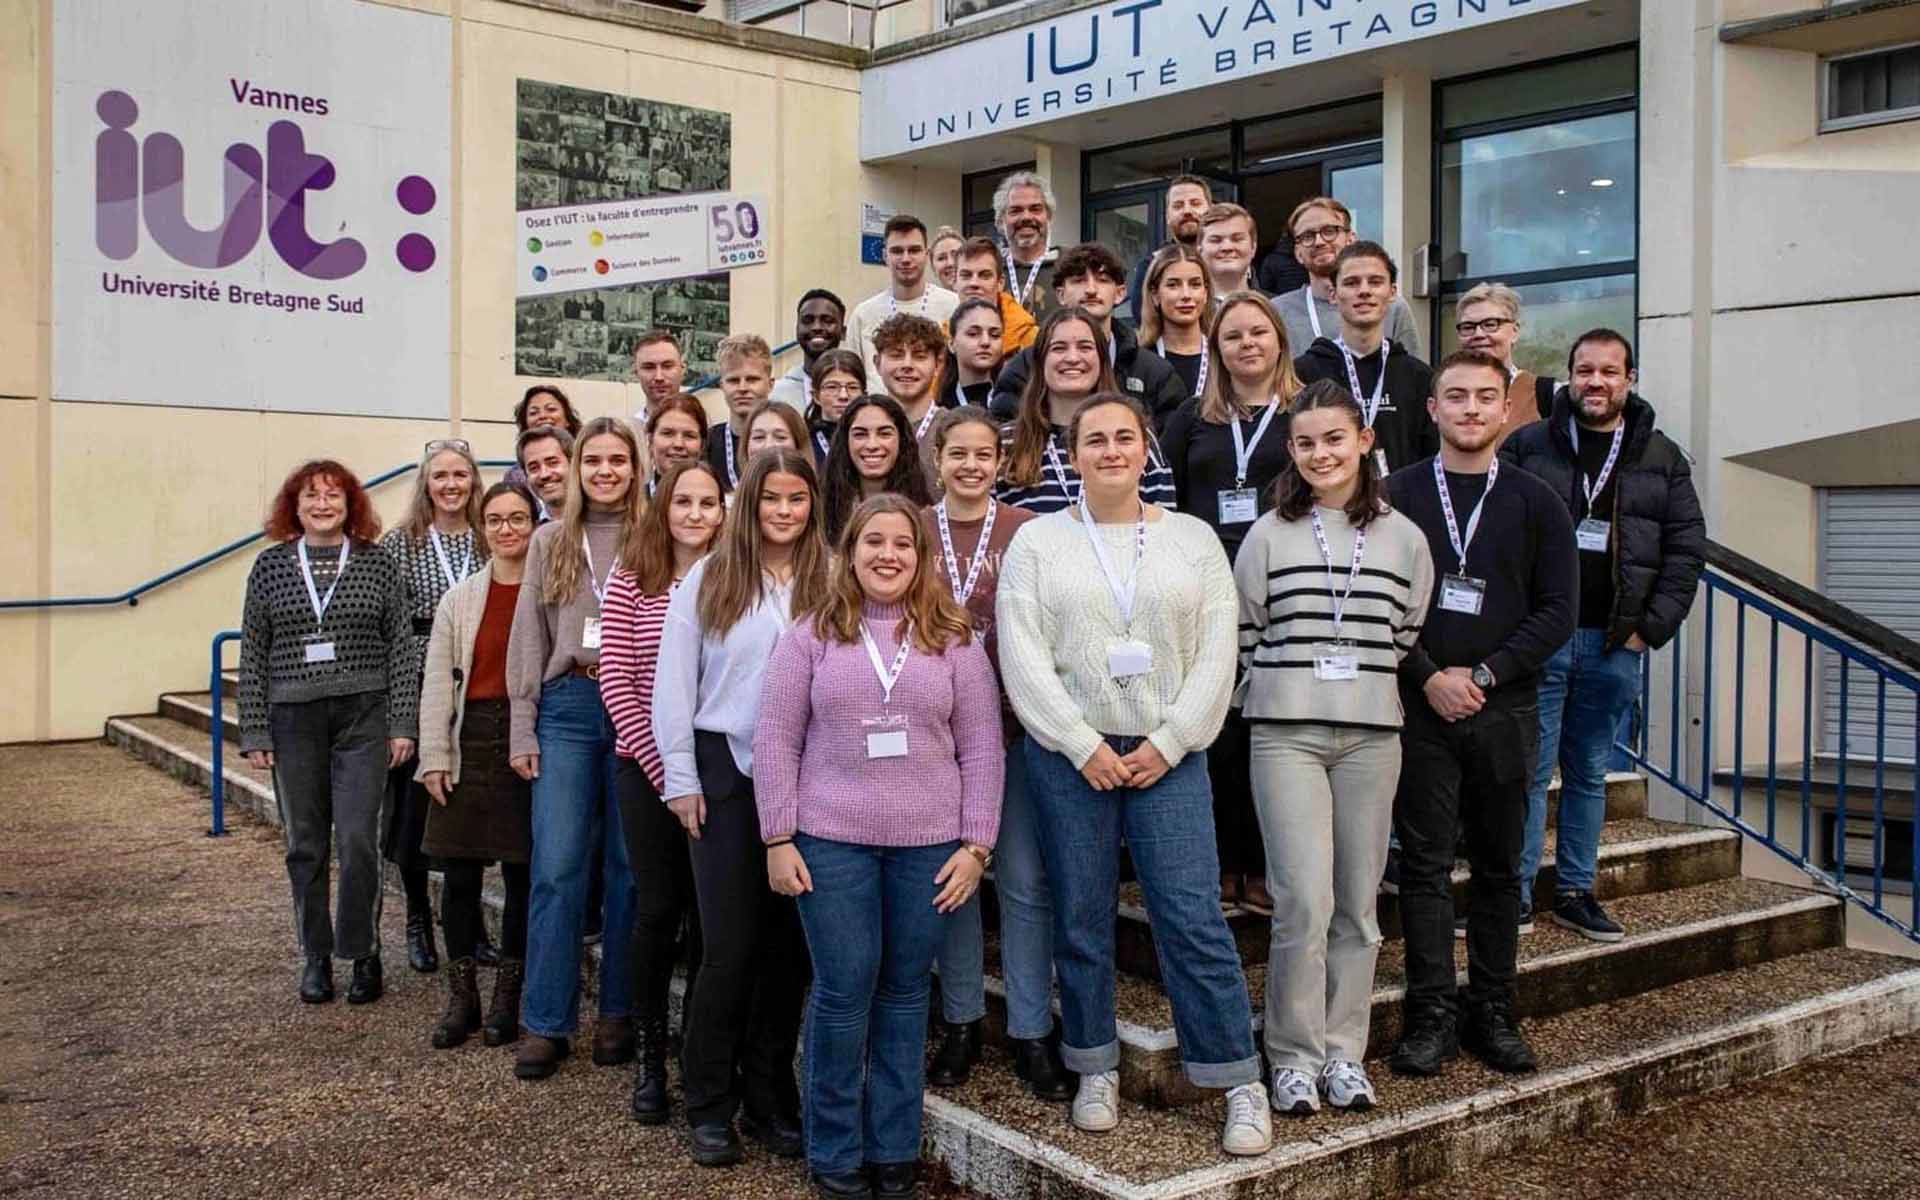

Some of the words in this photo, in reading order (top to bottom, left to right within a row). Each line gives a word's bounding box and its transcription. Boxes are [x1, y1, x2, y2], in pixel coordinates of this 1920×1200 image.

[1027, 0, 1162, 82] IUT
[909, 58, 1177, 141] UNIVERSITÉ
[1215, 0, 1531, 72] BRETAGN
[231, 79, 329, 115] Vannes
[526, 216, 551, 229] Osez
[586, 211, 596, 223] la
[597, 207, 630, 221] faculté
[711, 201, 759, 242] 50
[102, 272, 220, 301] Université
[228, 285, 321, 312] Bretagne
[327, 294, 364, 314] Sud
